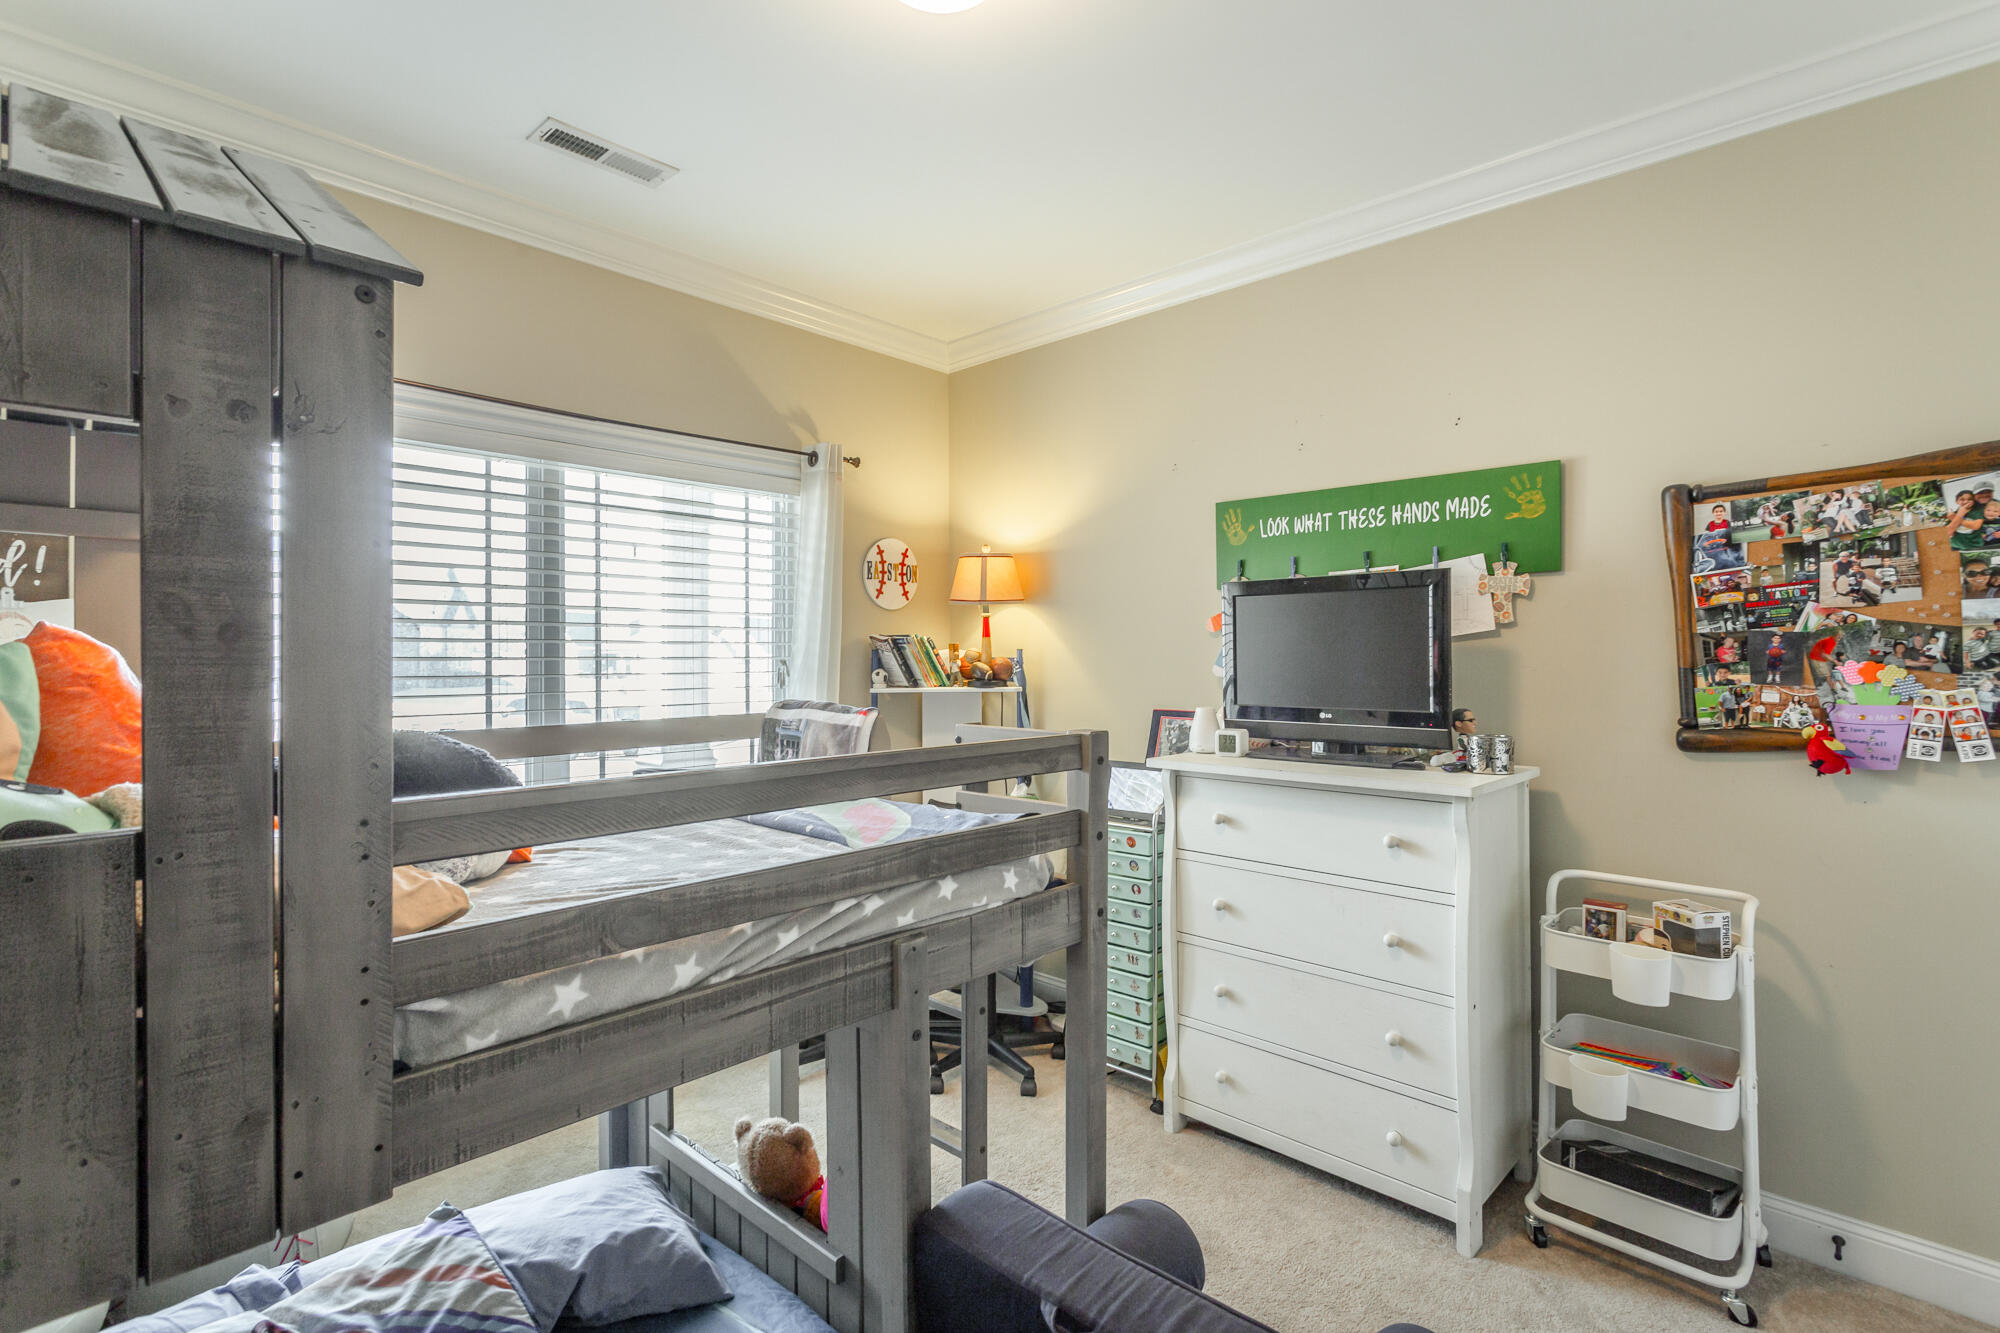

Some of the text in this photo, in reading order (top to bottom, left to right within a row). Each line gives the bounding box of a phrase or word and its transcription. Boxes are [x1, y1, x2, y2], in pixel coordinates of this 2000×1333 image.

[1259, 494, 1492, 538] LOOK WHAT THESE HANDS MADE
[866, 560, 918, 584] EASTON
[1768, 588, 1808, 600] EASTON
[1722, 915, 1730, 946] STEPHEN
